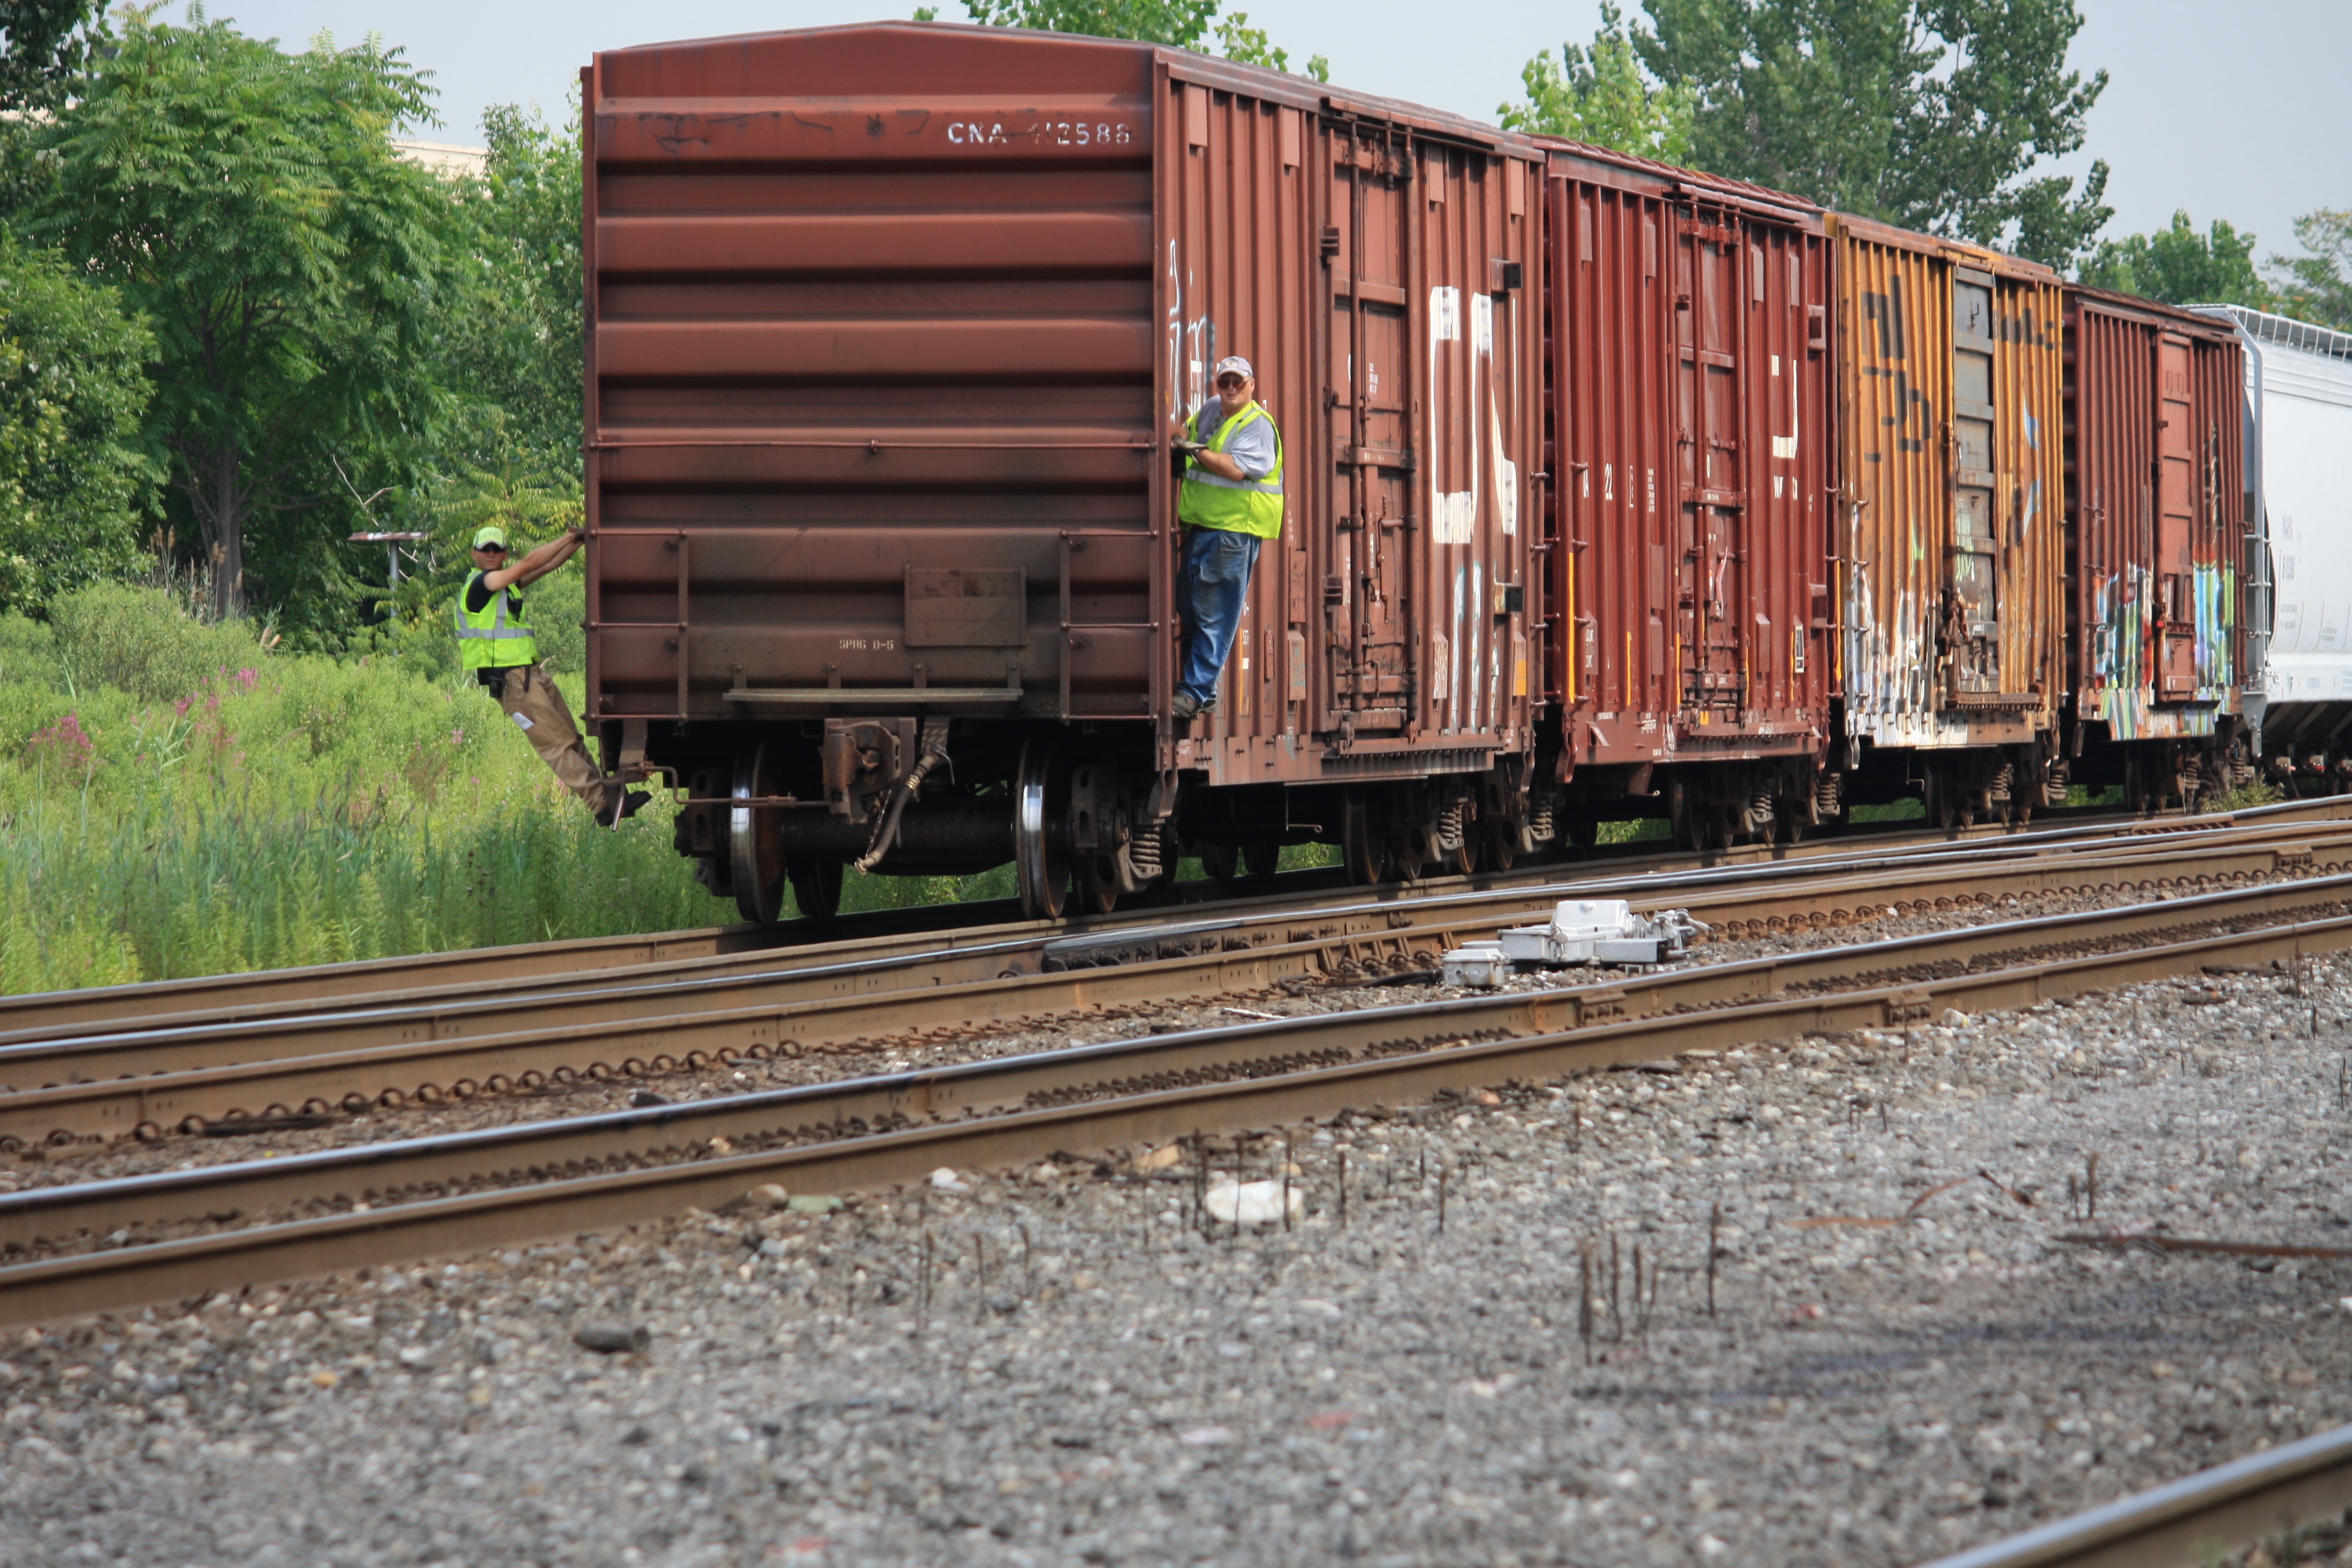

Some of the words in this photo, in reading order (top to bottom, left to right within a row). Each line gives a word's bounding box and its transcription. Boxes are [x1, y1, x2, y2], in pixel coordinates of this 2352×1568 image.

[947, 122, 1008, 143] CNA
[839, 639, 866, 649] SPRG
[873, 639, 893, 650] D-5
